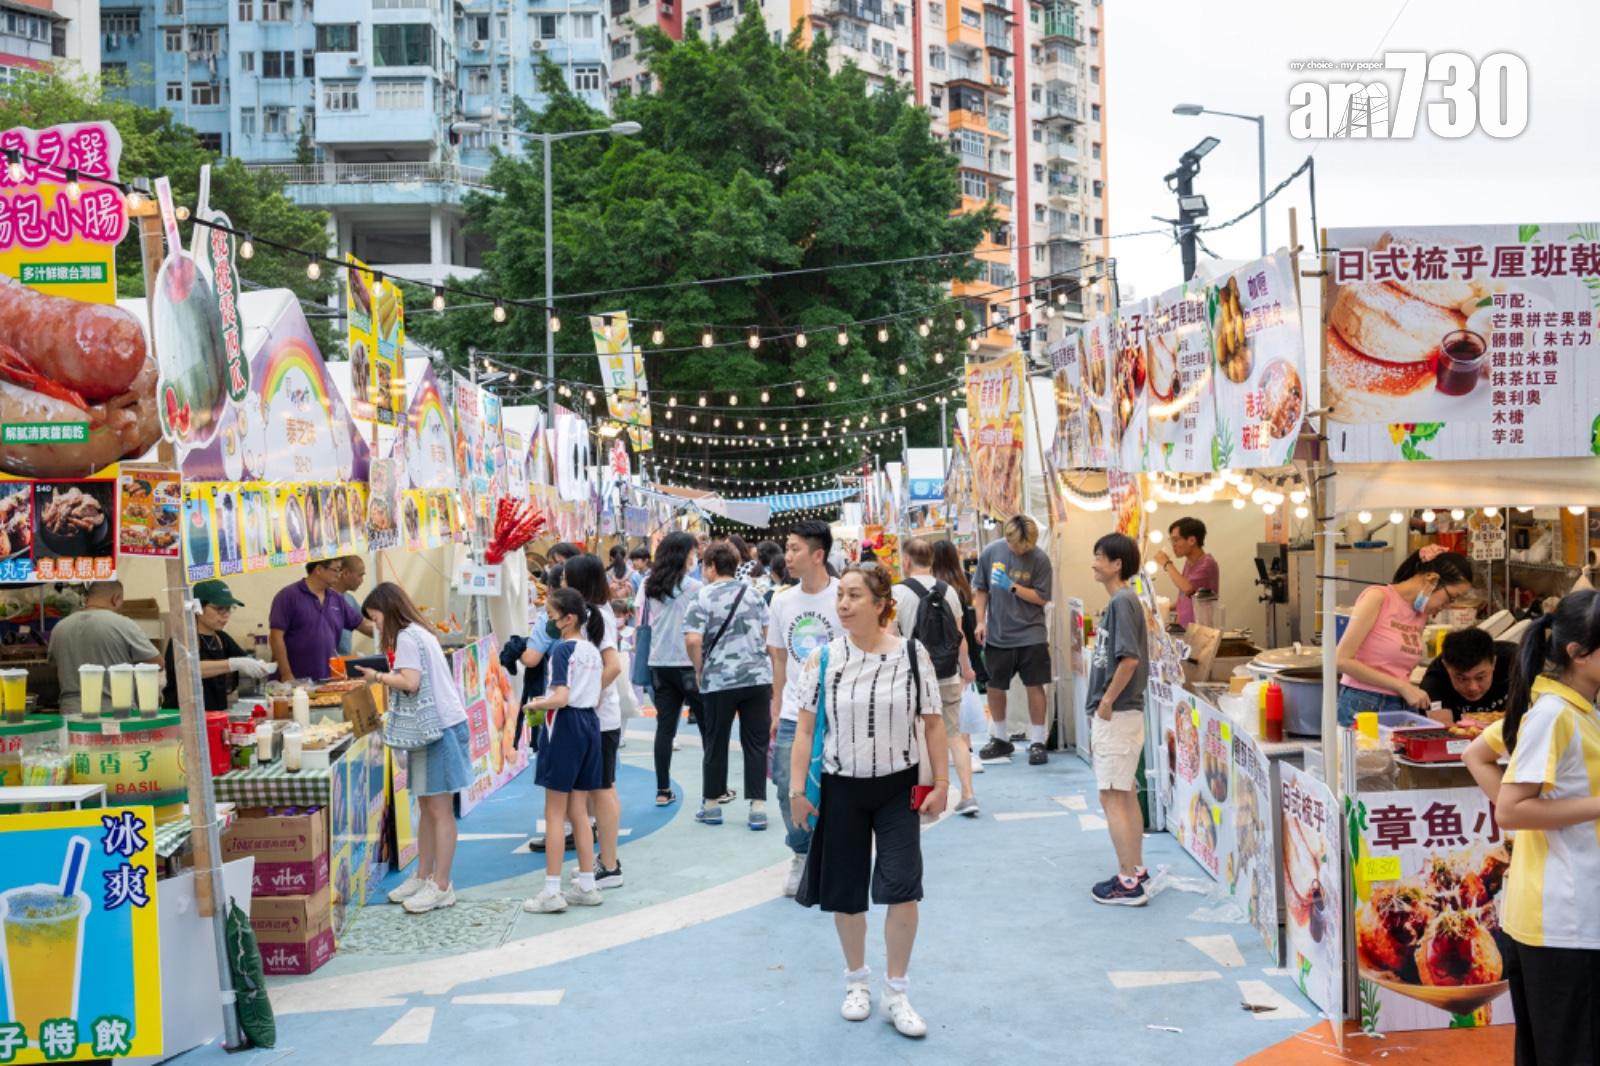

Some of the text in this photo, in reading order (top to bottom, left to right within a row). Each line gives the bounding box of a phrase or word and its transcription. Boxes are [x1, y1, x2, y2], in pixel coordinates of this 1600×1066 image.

[1492, 311, 1592, 328] 芒果拼芒果醬
[1492, 352, 1559, 367] 提拉米蘇
[1492, 371, 1558, 386] 抹茶紅豆
[1492, 390, 1541, 406] 奧利奧
[1492, 429, 1524, 445] 芋泥
[0, 559, 32, 579] 丸子
[115, 780, 162, 795] BASIL
[103, 813, 149, 909] 冰爽
[271, 867, 306, 887] vita
[266, 948, 300, 968] vita
[0, 1018, 128, 1059] 子特飲
